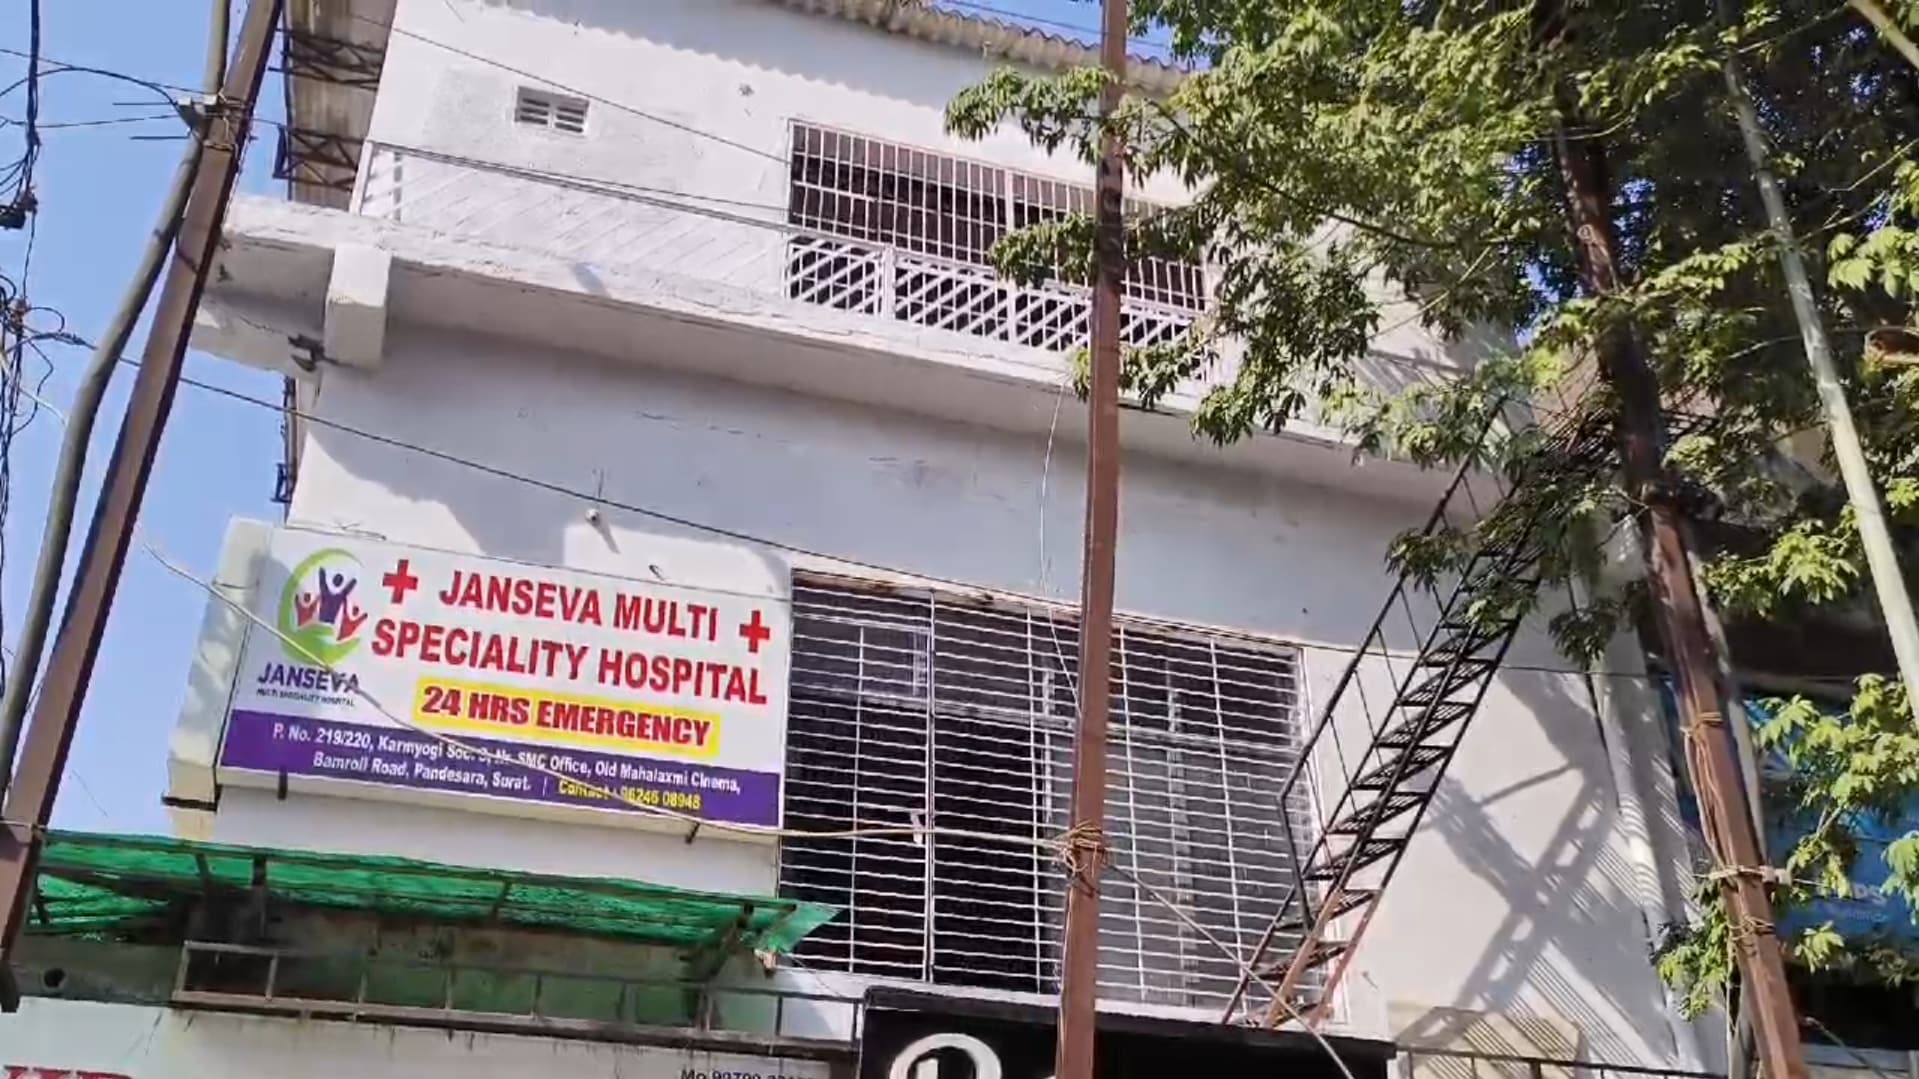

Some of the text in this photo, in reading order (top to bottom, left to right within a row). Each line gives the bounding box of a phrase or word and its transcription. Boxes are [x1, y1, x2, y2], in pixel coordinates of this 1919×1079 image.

[439, 570, 717, 641] JANSEVA MULTI
[258, 661, 359, 692] JANSEVA
[371, 618, 767, 704] SPECIALITY HOSPITAL
[421, 686, 711, 747] 24 HRS EMERGENCY
[273, 722, 285, 739] P.
[288, 725, 311, 742] No.
[315, 727, 374, 752] 219/220,
[378, 736, 443, 761] Karmyogi
[517, 751, 546, 770] SMC
[550, 754, 591, 778] Office,
[595, 761, 616, 778] Old
[620, 764, 689, 785] Mahalaxmi
[691, 771, 741, 795] Cinema,
[414, 765, 488, 790] Pandesara,
[492, 771, 531, 791] Surat.
